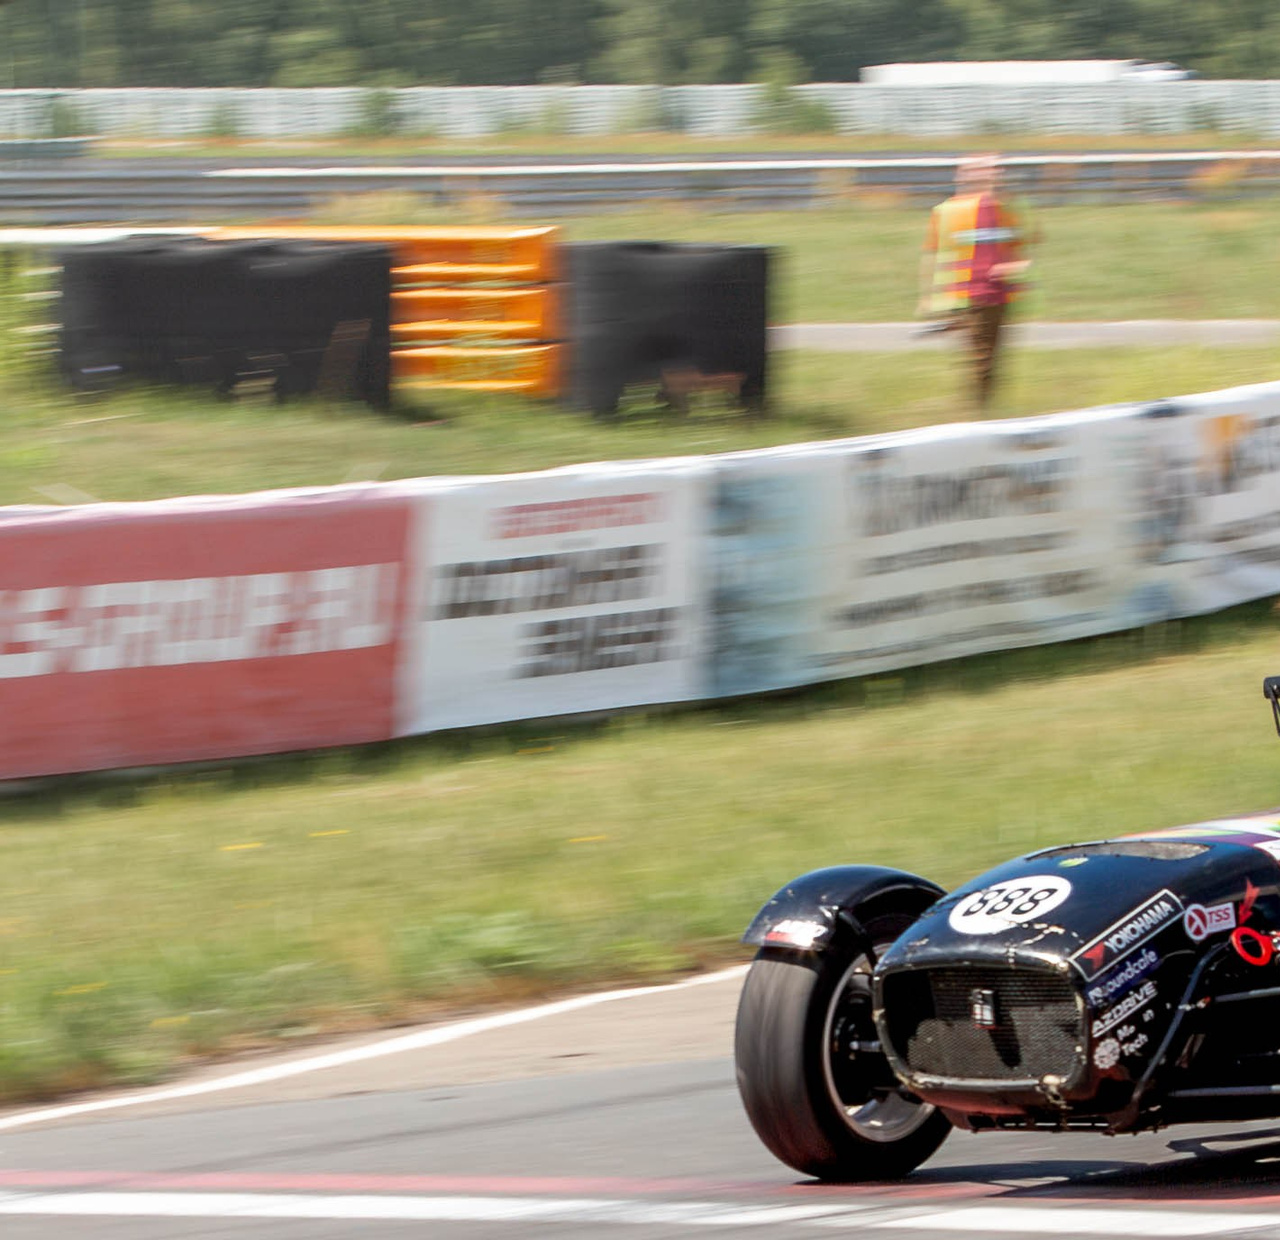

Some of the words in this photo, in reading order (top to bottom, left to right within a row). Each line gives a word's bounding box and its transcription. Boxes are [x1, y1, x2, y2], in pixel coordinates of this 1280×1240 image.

[961, 887, 1059, 917] 888
[1209, 907, 1231, 924] TSS
[1104, 900, 1174, 953] YOKOHAMA
